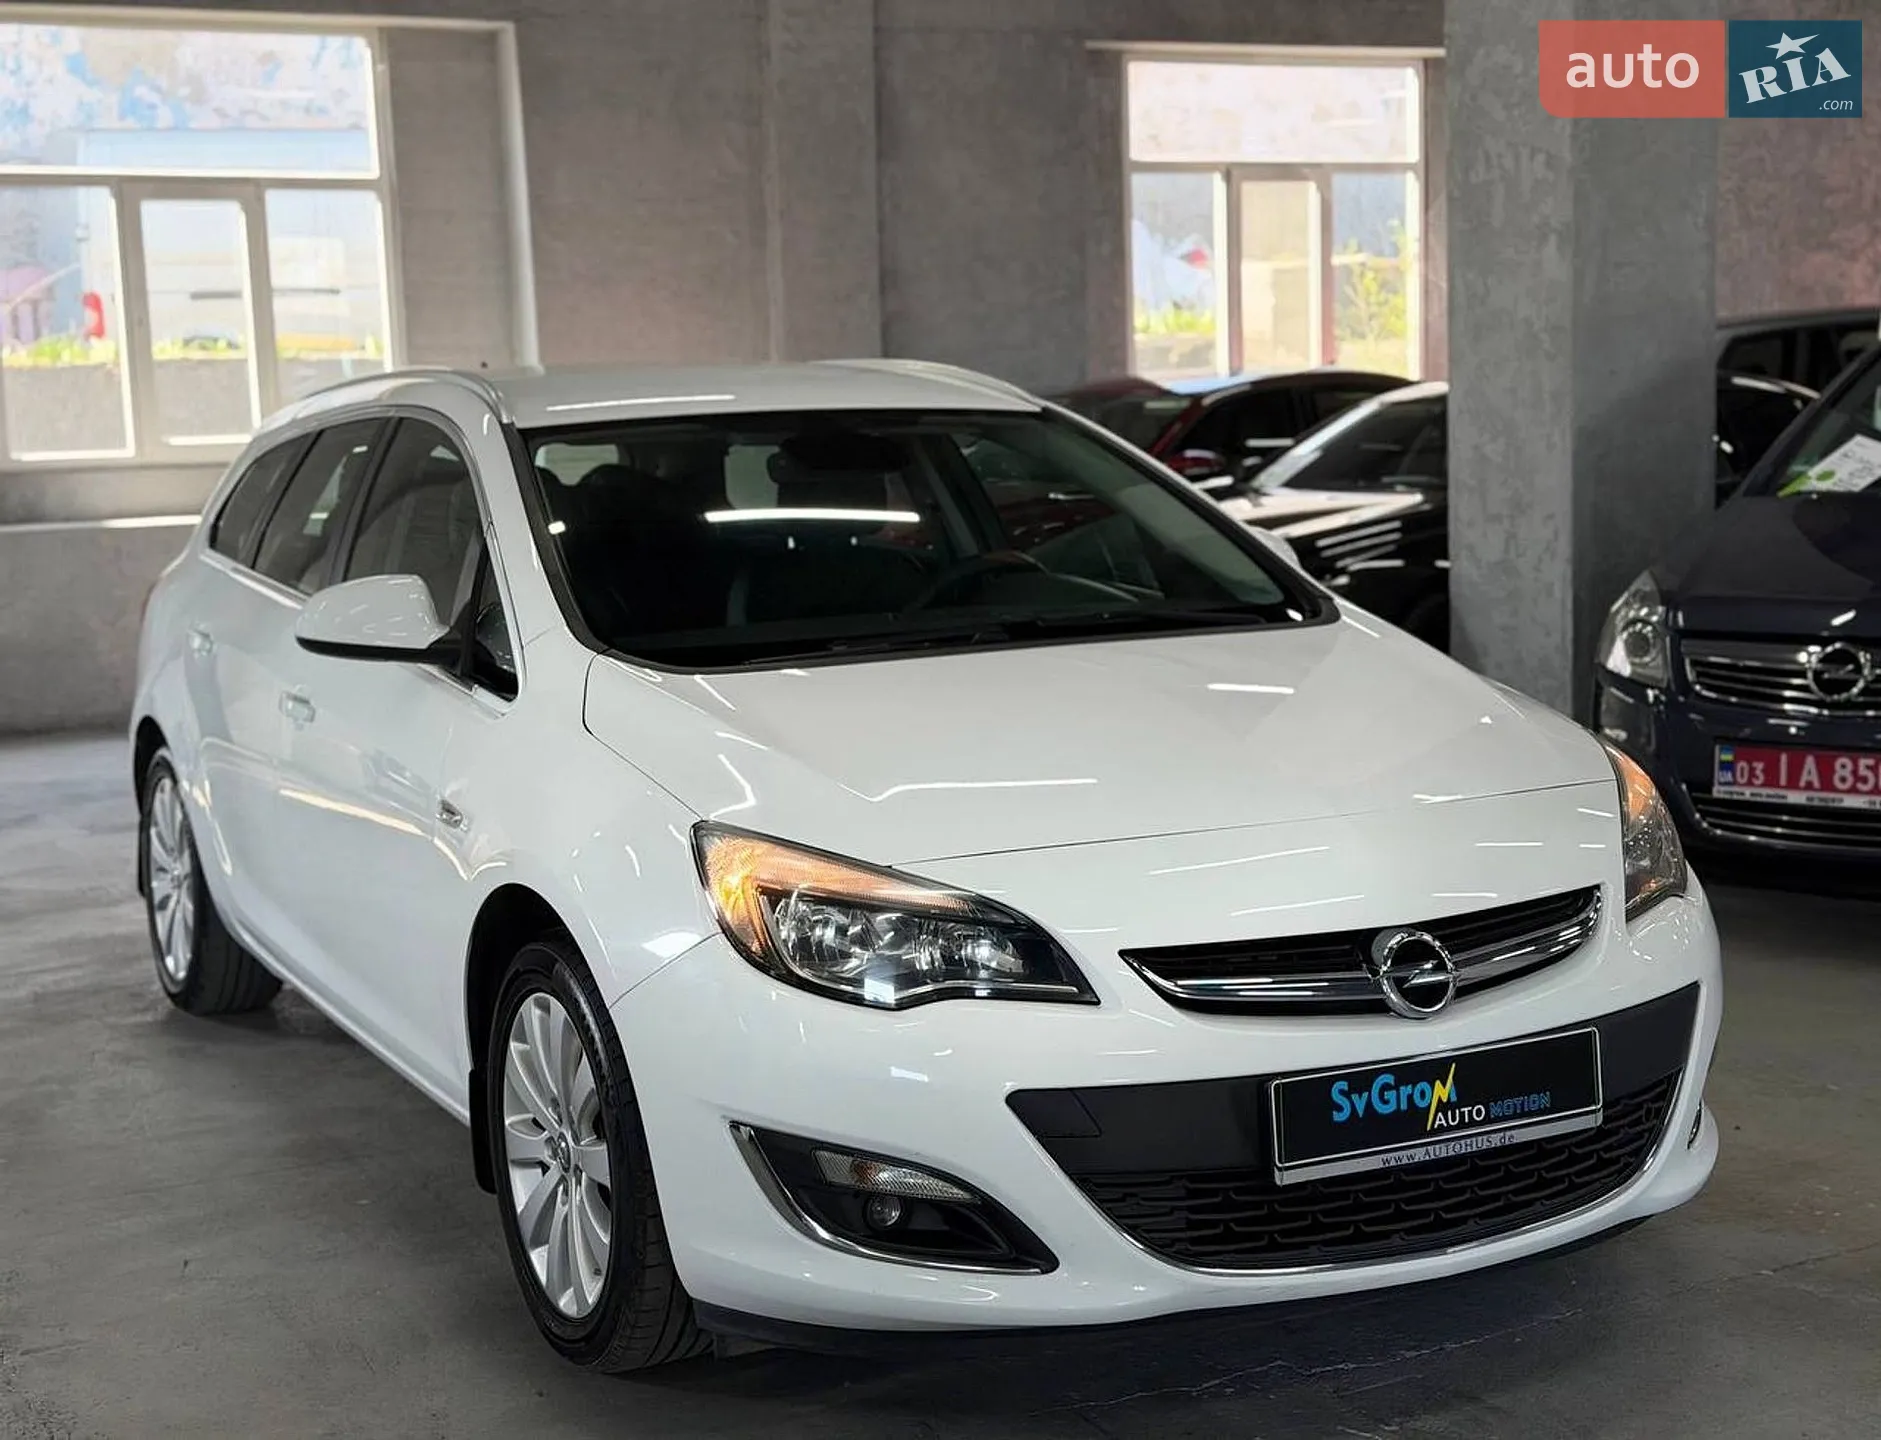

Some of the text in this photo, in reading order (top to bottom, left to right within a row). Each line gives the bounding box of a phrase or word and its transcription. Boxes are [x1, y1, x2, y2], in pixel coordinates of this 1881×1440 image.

[1736, 761, 1764, 785] 03
[1833, 757, 1881, 791] 85
[1434, 1105, 1485, 1128] AUTO
